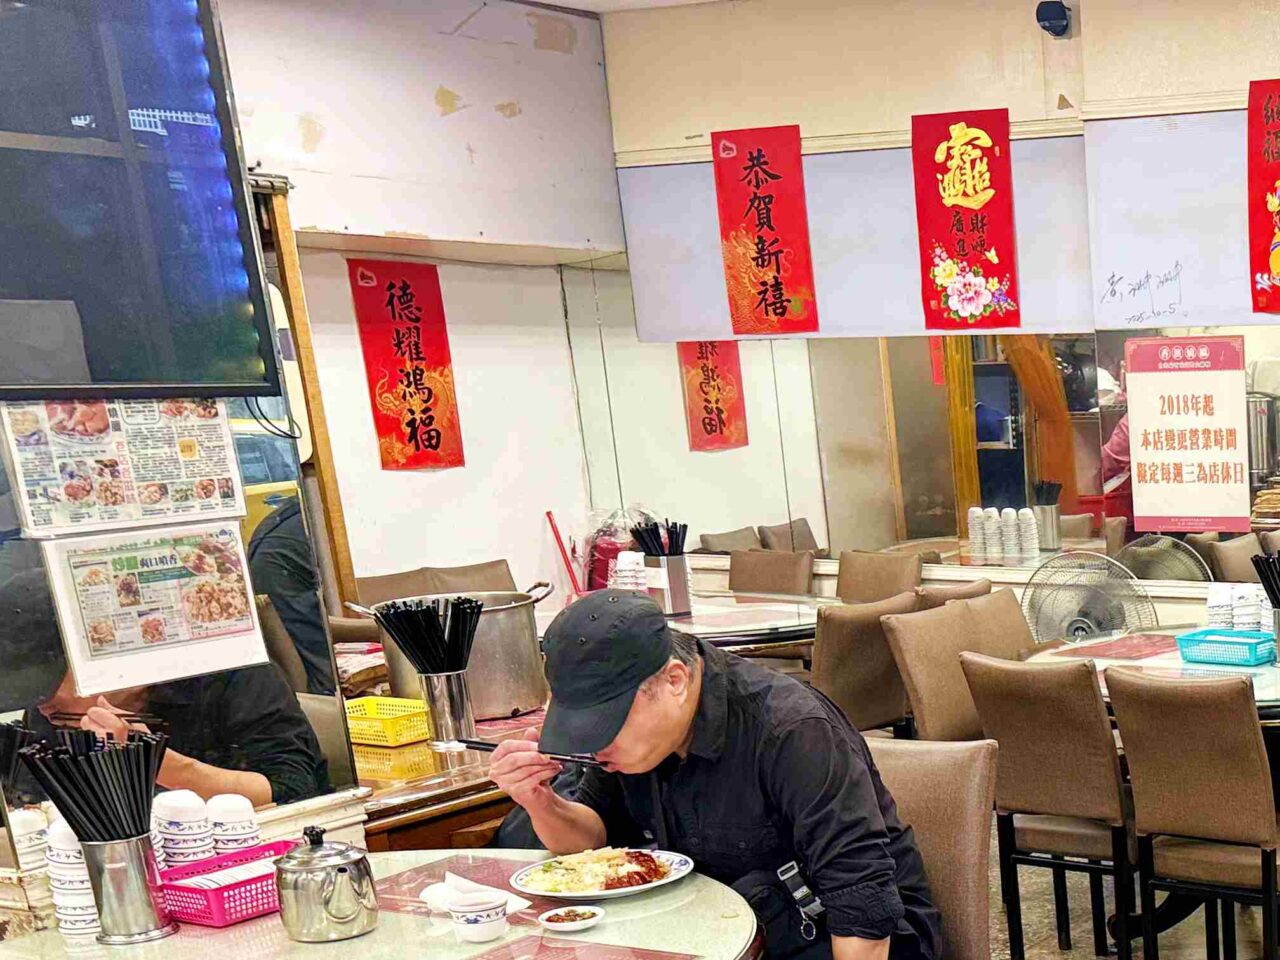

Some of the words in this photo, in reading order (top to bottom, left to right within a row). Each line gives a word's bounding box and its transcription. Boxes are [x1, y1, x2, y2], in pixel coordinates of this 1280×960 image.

[738, 147, 793, 319] 恭賀新禧
[948, 209, 969, 258] 廣進
[385, 279, 443, 452] 德耀鴻福
[1159, 394, 1215, 417] 2018年起
[1140, 427, 1238, 451] 本店變更營業時間
